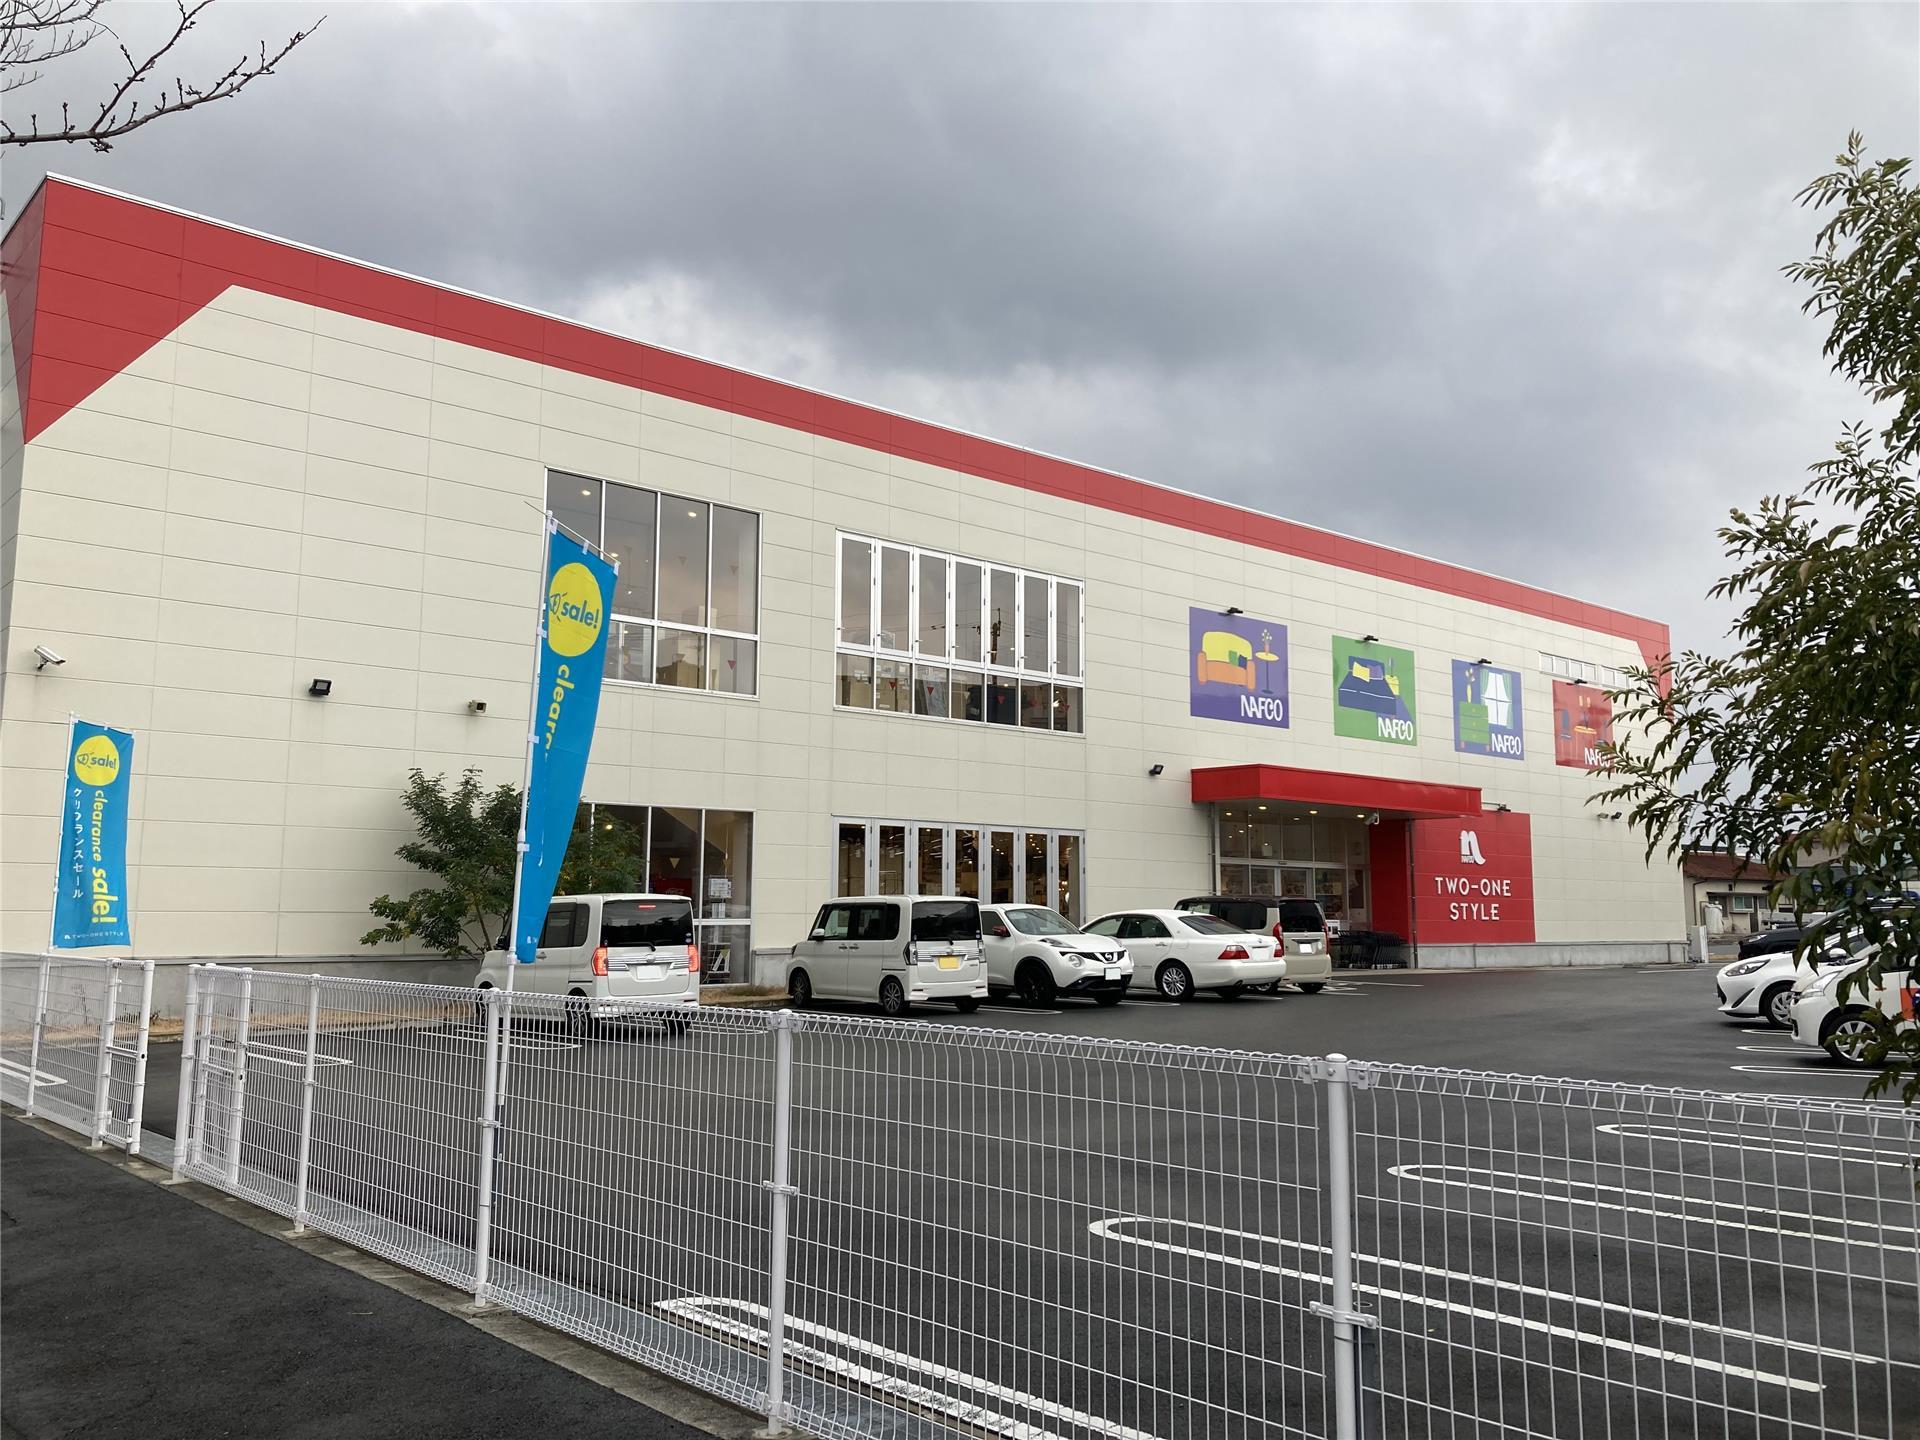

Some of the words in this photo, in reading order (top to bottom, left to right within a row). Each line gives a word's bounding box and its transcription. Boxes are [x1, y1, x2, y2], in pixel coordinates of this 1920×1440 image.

[561, 600, 600, 629] sale!
[1240, 694, 1283, 722] NAFCO
[1377, 717, 1414, 741] NAFCO
[1491, 733, 1522, 755] NAFCO
[90, 754, 117, 770] sale!
[91, 790, 108, 862] clearance
[91, 867, 119, 924] sale!
[1435, 877, 1512, 897] TWO-ONE
[1449, 903, 1500, 921] STYLE
